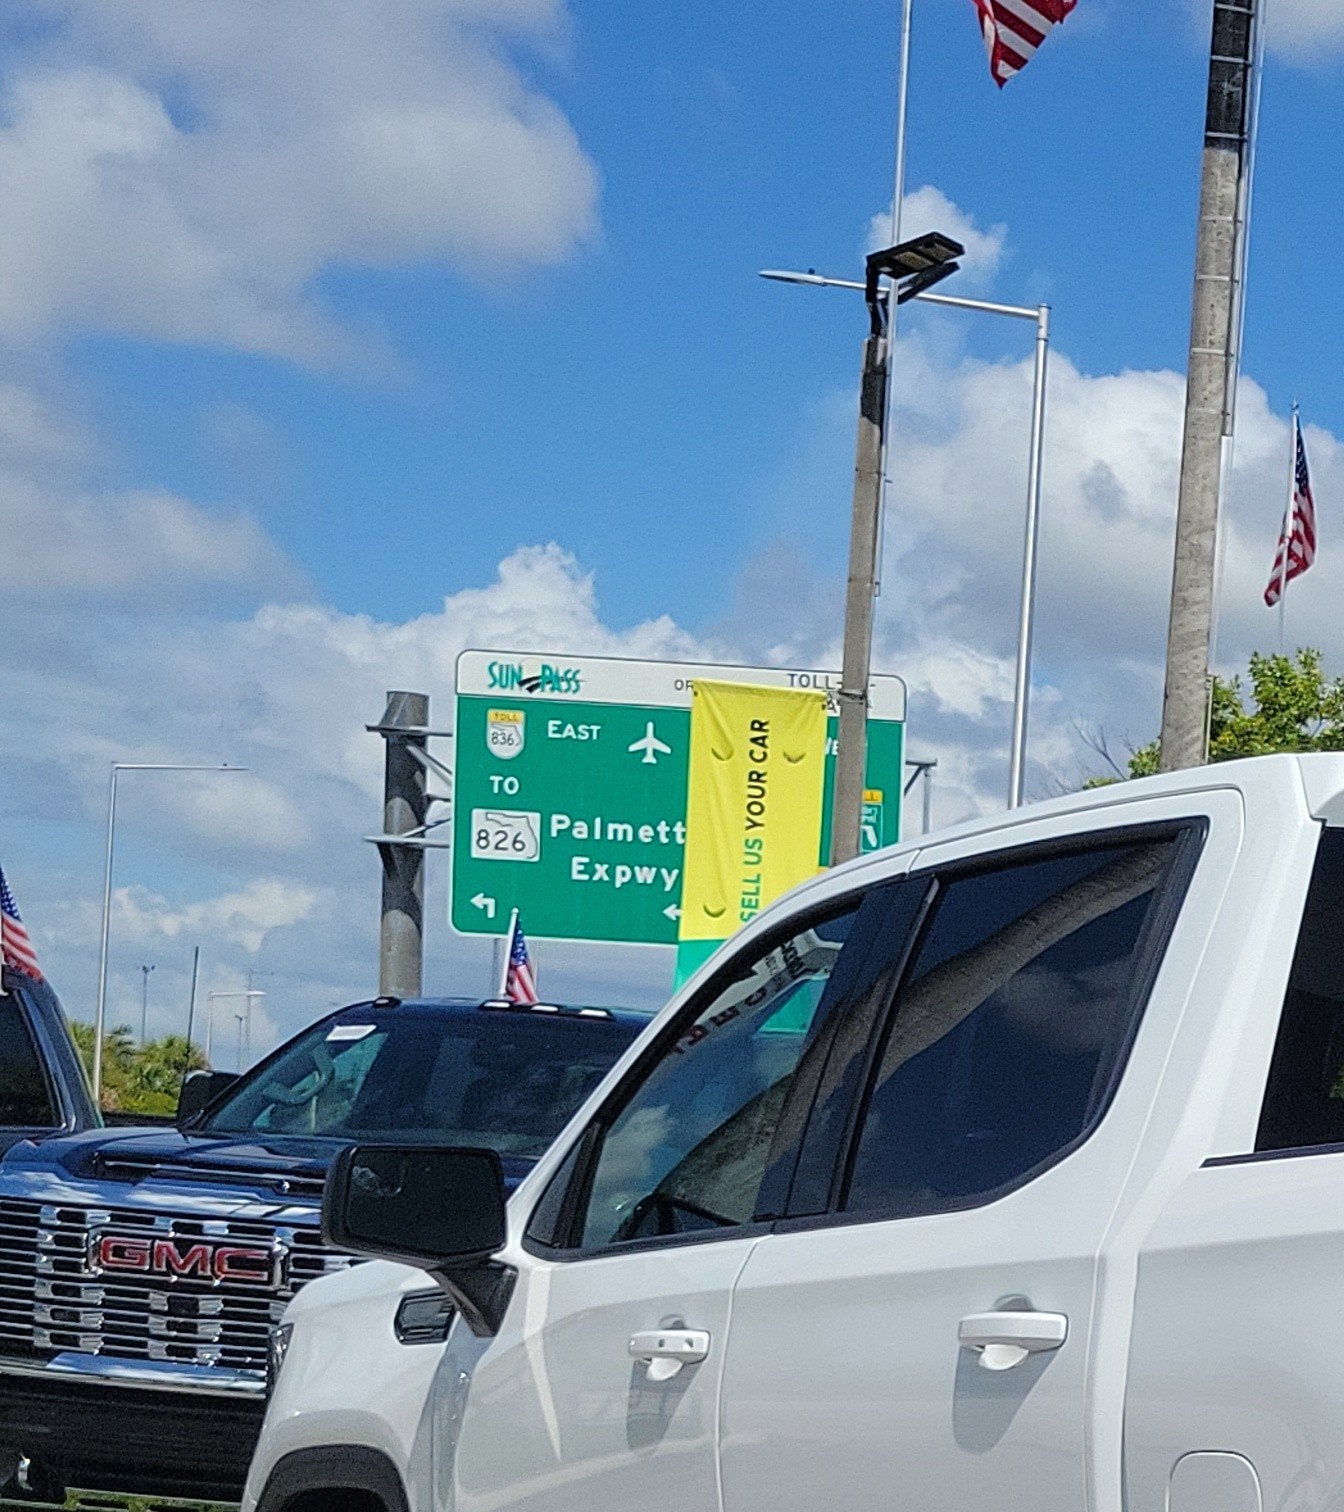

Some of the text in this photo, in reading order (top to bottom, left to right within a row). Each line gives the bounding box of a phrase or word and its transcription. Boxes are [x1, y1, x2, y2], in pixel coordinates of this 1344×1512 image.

[487, 661, 581, 694] SUN PASS
[491, 732, 514, 746] 836
[548, 720, 601, 740] EAST
[489, 776, 519, 795] TO
[550, 813, 687, 845] Palmett
[739, 719, 770, 923] SELL US YOUR CAR
[476, 829, 526, 852] 826
[571, 856, 679, 892] Expwy
[100, 1236, 270, 1281] GMC
